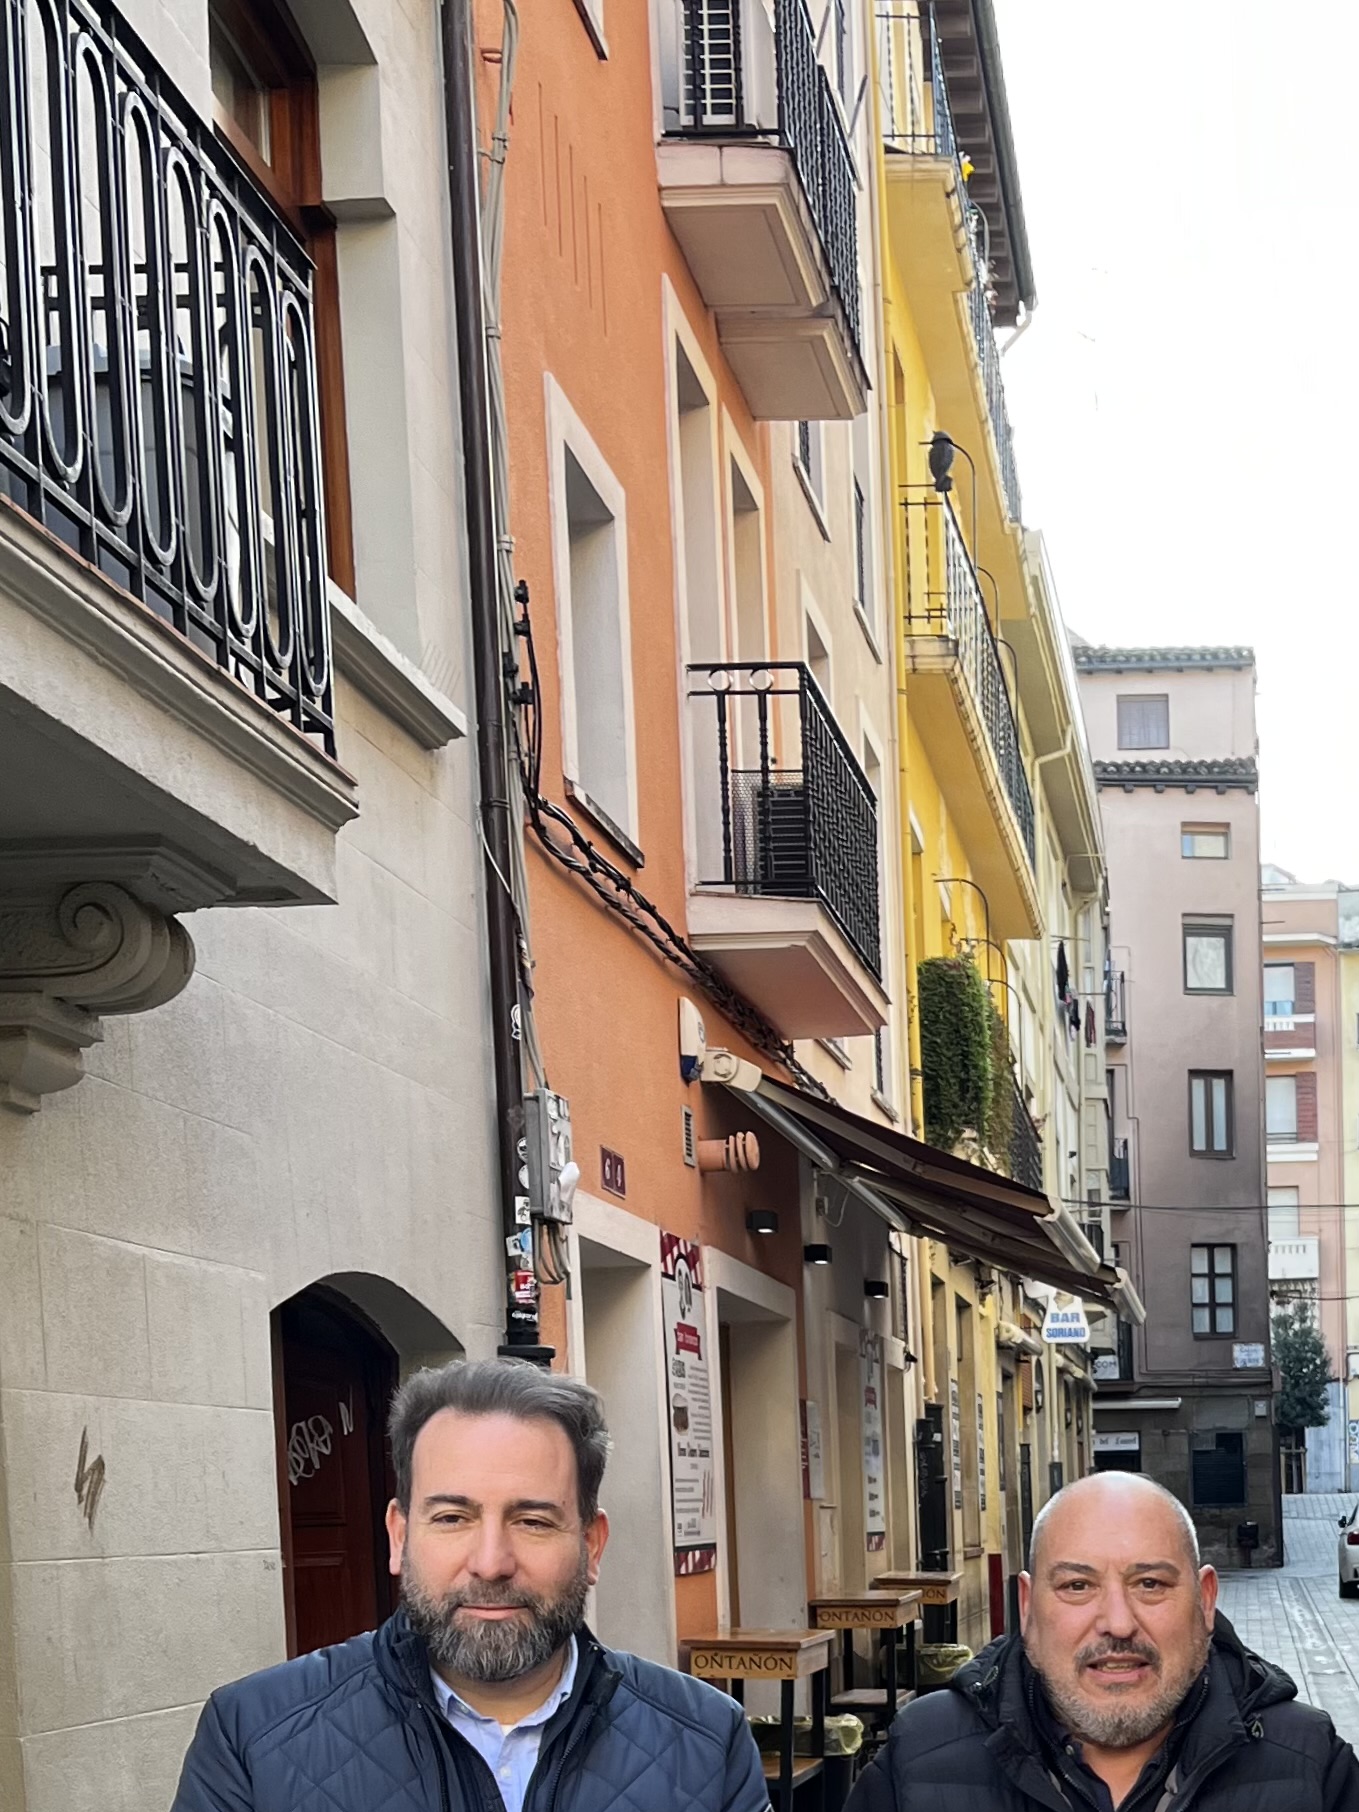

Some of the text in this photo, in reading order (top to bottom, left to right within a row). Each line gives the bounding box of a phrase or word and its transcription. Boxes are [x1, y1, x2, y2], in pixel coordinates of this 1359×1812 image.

[1050, 1312, 1081, 1324] BAR
[1046, 1327, 1086, 1338] SORIANO
[819, 1607, 896, 1623] ONTAÑÓN
[694, 1652, 795, 1672] ONTAÑÓN
